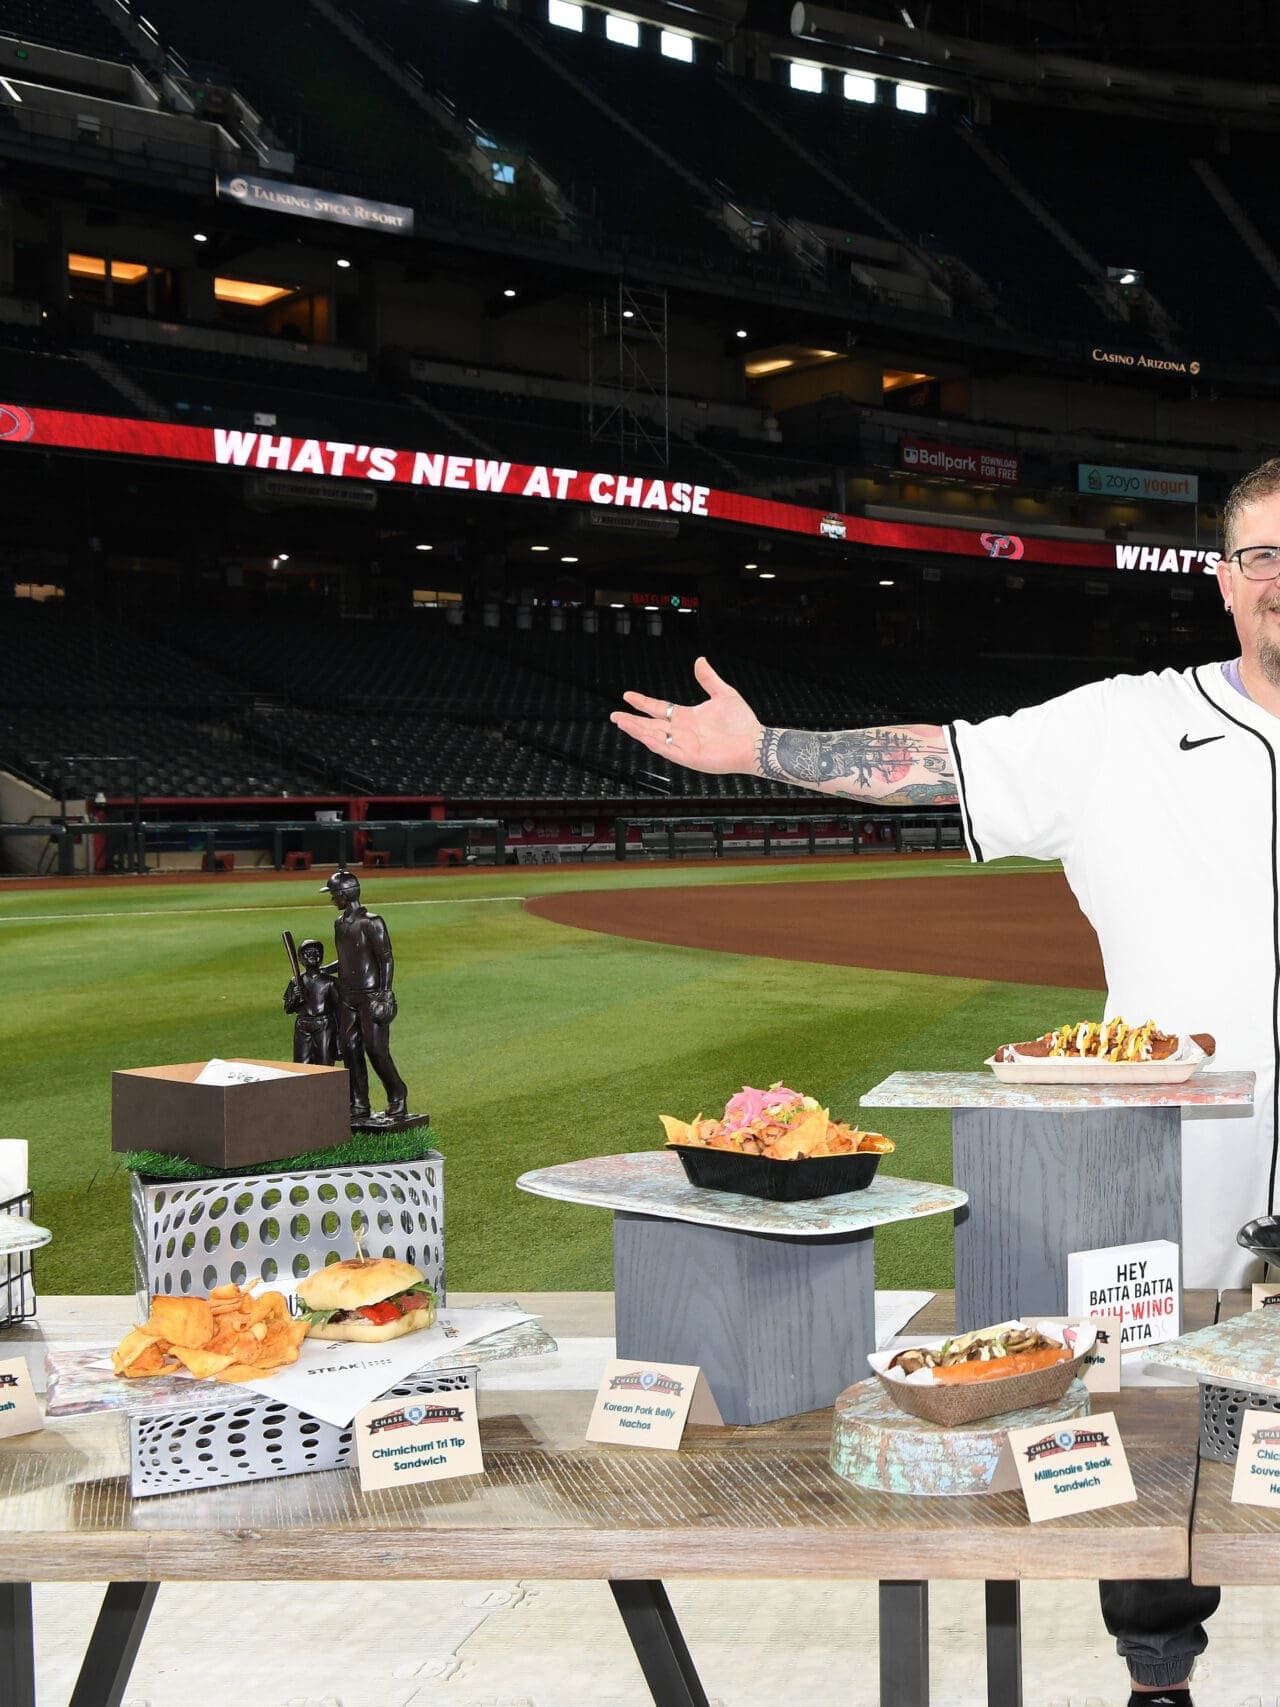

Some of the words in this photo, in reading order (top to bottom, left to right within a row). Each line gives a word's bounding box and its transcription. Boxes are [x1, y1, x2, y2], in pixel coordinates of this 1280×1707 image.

[250, 184, 310, 209] TALKING
[314, 198, 351, 217] STICK
[355, 207, 404, 227] RESORT
[1092, 348, 1135, 365] CASINO
[1137, 355, 1187, 372] ARIZONA
[920, 449, 977, 471] Ballpark
[980, 455, 1018, 469] DOWNLOAD
[213, 428, 398, 482] WHAT'S
[412, 452, 511, 493] NEW
[522, 465, 578, 500] AT
[589, 473, 711, 516] CHASE
[980, 465, 997, 478] FOR
[998, 467, 1018, 480] FREE
[1105, 474, 1140, 492] zoyo
[1144, 479, 1191, 496] yogurt
[1115, 545, 1221, 575] WHAT'S
[1117, 1260, 1147, 1283] HEY
[1090, 1285, 1130, 1306] BATTA
[1134, 1278, 1174, 1298] BATTA
[1120, 1323, 1152, 1343] ATTA
[307, 1363, 359, 1376] STEAK
[616, 1376, 639, 1385] CHASE
[657, 1380, 679, 1390] FIELD
[375, 1415, 403, 1427] CHASE
[428, 1409, 457, 1418] FIELD
[603, 1402, 633, 1413] Korean
[635, 1405, 653, 1415] Pork
[655, 1407, 676, 1419] Belly
[619, 1418, 651, 1430] Nachos
[372, 1440, 434, 1459] Chimichurri
[436, 1437, 449, 1449] Tri
[449, 1437, 465, 1449] Tip
[1031, 1443, 1055, 1454] CHASE
[1078, 1434, 1103, 1442] FIELD
[394, 1455, 447, 1471] Sandwich
[1034, 1464, 1083, 1482] Millionaire
[1085, 1457, 1112, 1471] Steak
[1054, 1476, 1101, 1494] Sandwich
